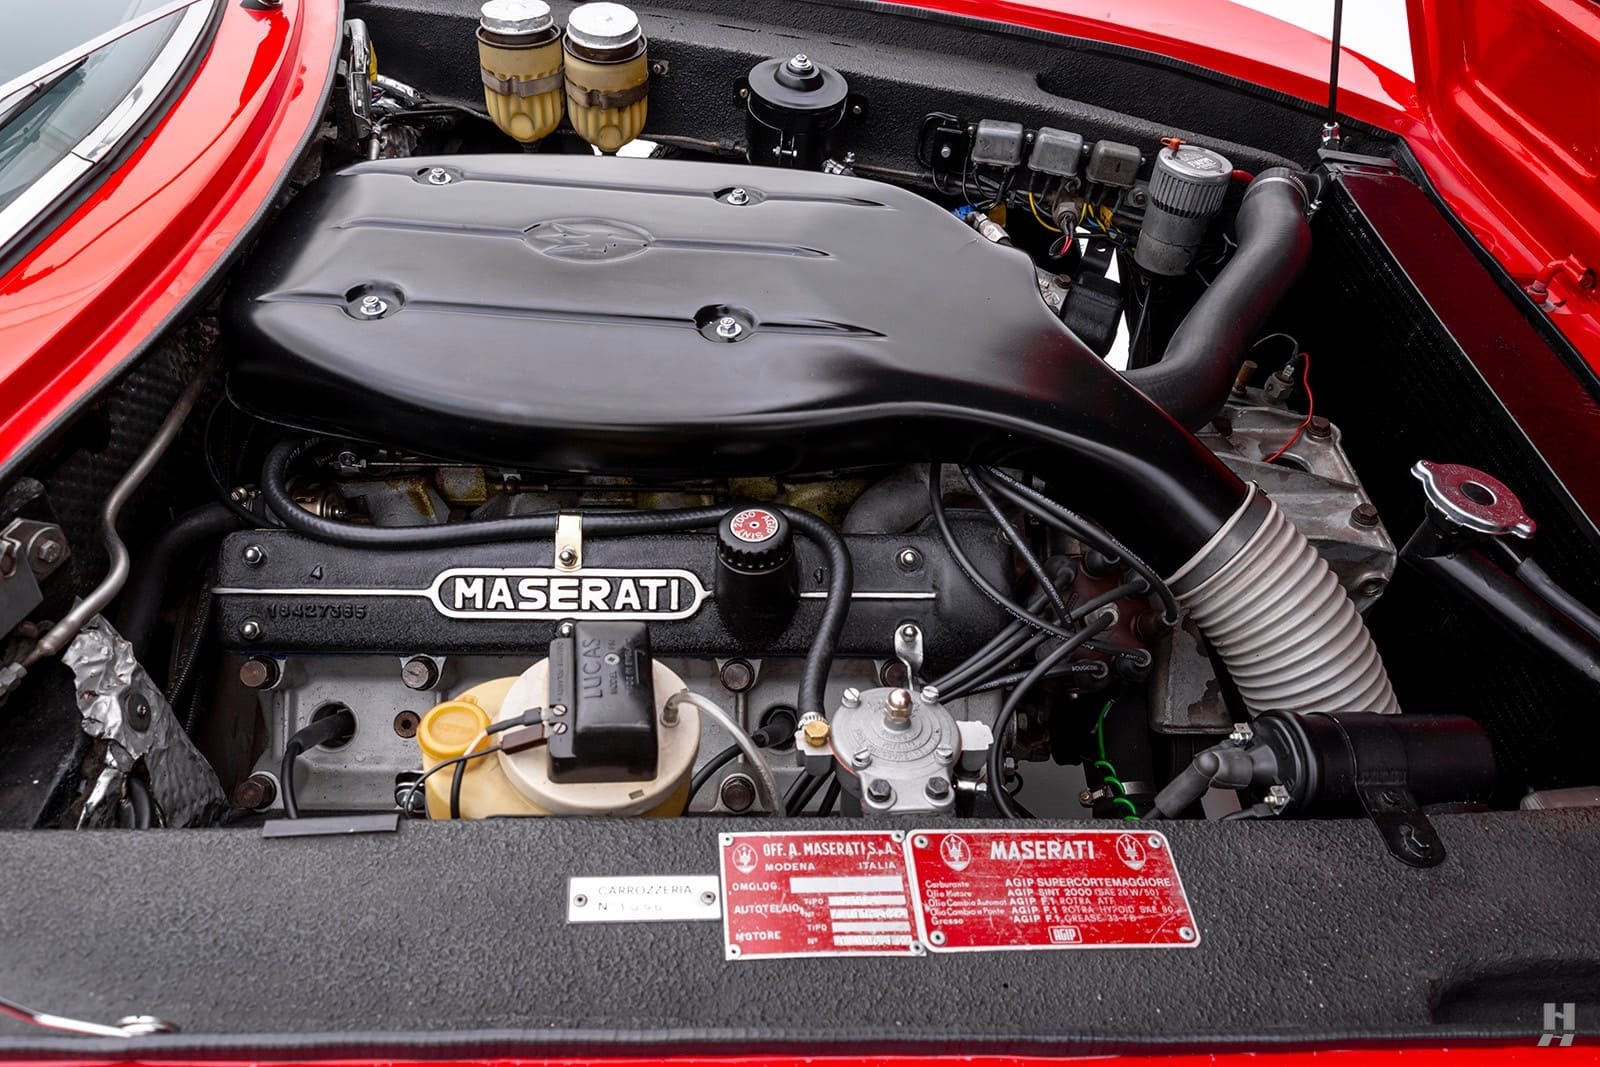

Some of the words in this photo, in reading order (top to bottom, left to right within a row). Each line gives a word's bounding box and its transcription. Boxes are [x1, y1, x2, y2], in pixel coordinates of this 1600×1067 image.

[734, 511, 756, 528] 2000
[760, 515, 775, 534] AGIP
[736, 528, 763, 540] SINT
[454, 578, 680, 612] MASERATI
[582, 637, 604, 700] LUCAS
[762, 842, 787, 857] OFF.
[788, 841, 801, 857] A.
[803, 841, 866, 857] MASERATI
[990, 840, 1095, 860] MASERATI
[764, 862, 816, 873] MODENA
[858, 860, 897, 871] ITALIA
[731, 881, 781, 892] OMOLOG.
[925, 879, 970, 889] Carburante
[1005, 878, 1034, 888] AGIP
[1036, 877, 1172, 888] SUPERCORTEMAGGIORE
[598, 884, 693, 896] CARROZZERIA
[1007, 888, 1034, 897] AGIP
[1038, 888, 1060, 897] SINT
[1063, 888, 1093, 897] 2000
[803, 897, 825, 906] TIPO
[1009, 897, 1036, 906] AGIP
[733, 903, 800, 915] AUTOTELAIO
[1011, 906, 1038, 915] AGIP
[1013, 914, 1041, 924] AGIP
[807, 923, 828, 932] TIPO
[735, 930, 782, 942] MOTORE
[1053, 928, 1077, 941] AGIP
